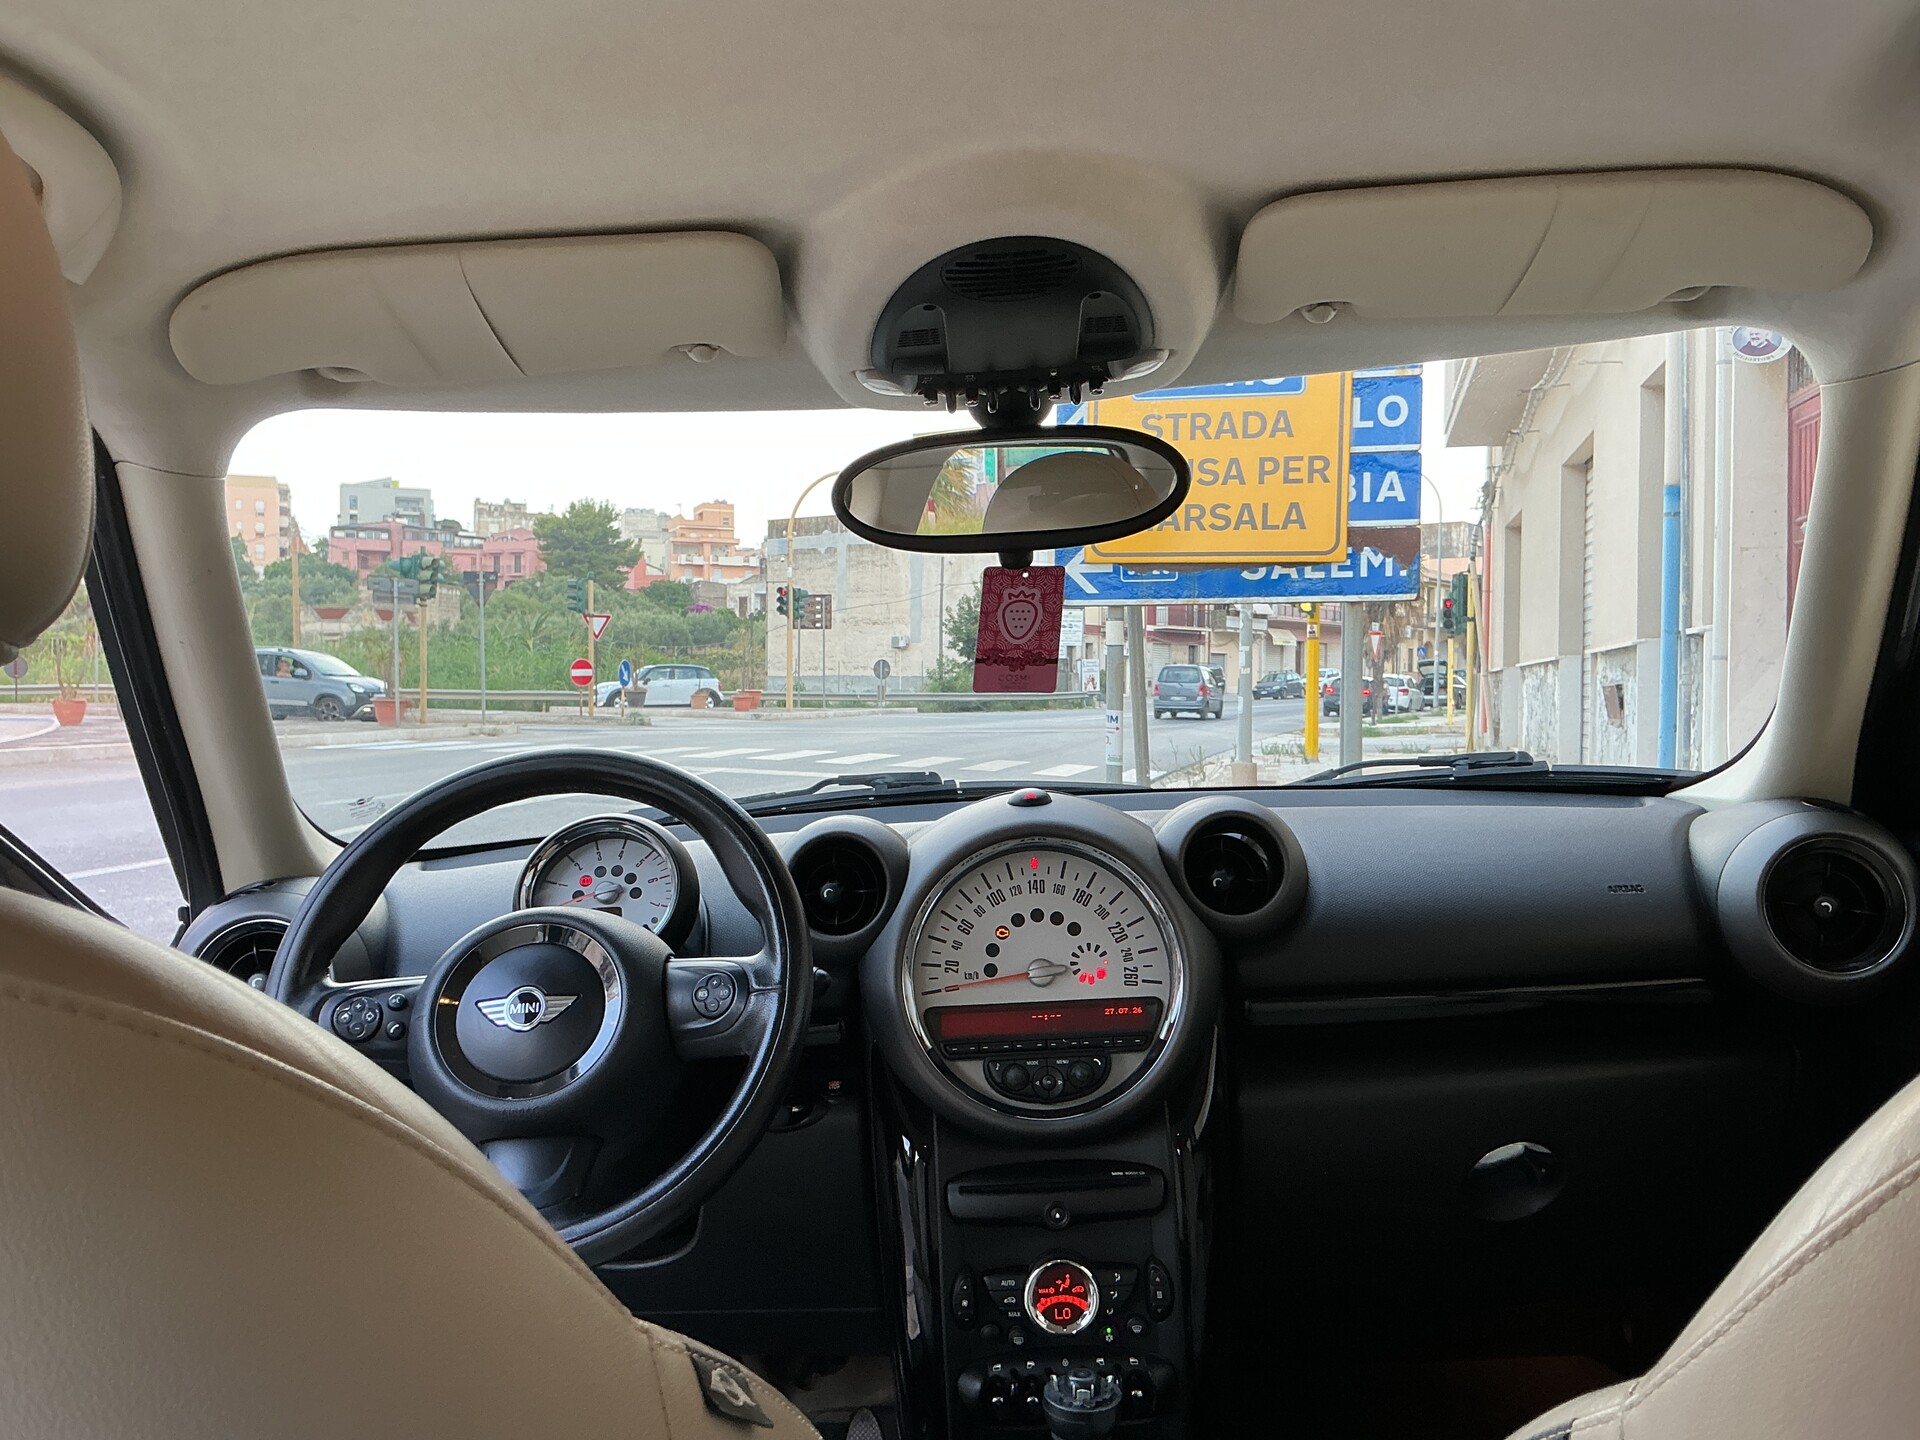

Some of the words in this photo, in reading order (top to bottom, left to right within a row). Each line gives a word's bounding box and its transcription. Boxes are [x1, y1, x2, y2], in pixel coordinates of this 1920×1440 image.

[1141, 409, 1295, 442] STRADA
[1258, 454, 1331, 485] PER
[1148, 501, 1307, 532] ARSALA
[596, 851, 602, 862] 3
[617, 850, 625, 861] 4
[574, 862, 583, 871] 2
[635, 858, 645, 868] 5
[1008, 884, 1023, 898] 120
[1027, 879, 1046, 895] 140
[1052, 883, 1066, 896] 160
[986, 888, 1007, 908] 100
[1072, 888, 1093, 908] 180
[974, 904, 987, 918] 80
[1093, 904, 1110, 921] 200
[957, 918, 975, 936] 60
[1107, 921, 1129, 944] 220
[951, 939, 963, 951] 40
[1120, 947, 1134, 963] 240
[944, 960, 960, 974] 20
[1123, 966, 1139, 987] 260
[509, 1001, 540, 1015] MINI
[1104, 1007, 1143, 1016] 27.07.26
[1000, 1279, 1016, 1287] AUTO
[1054, 1307, 1071, 1320] LO
